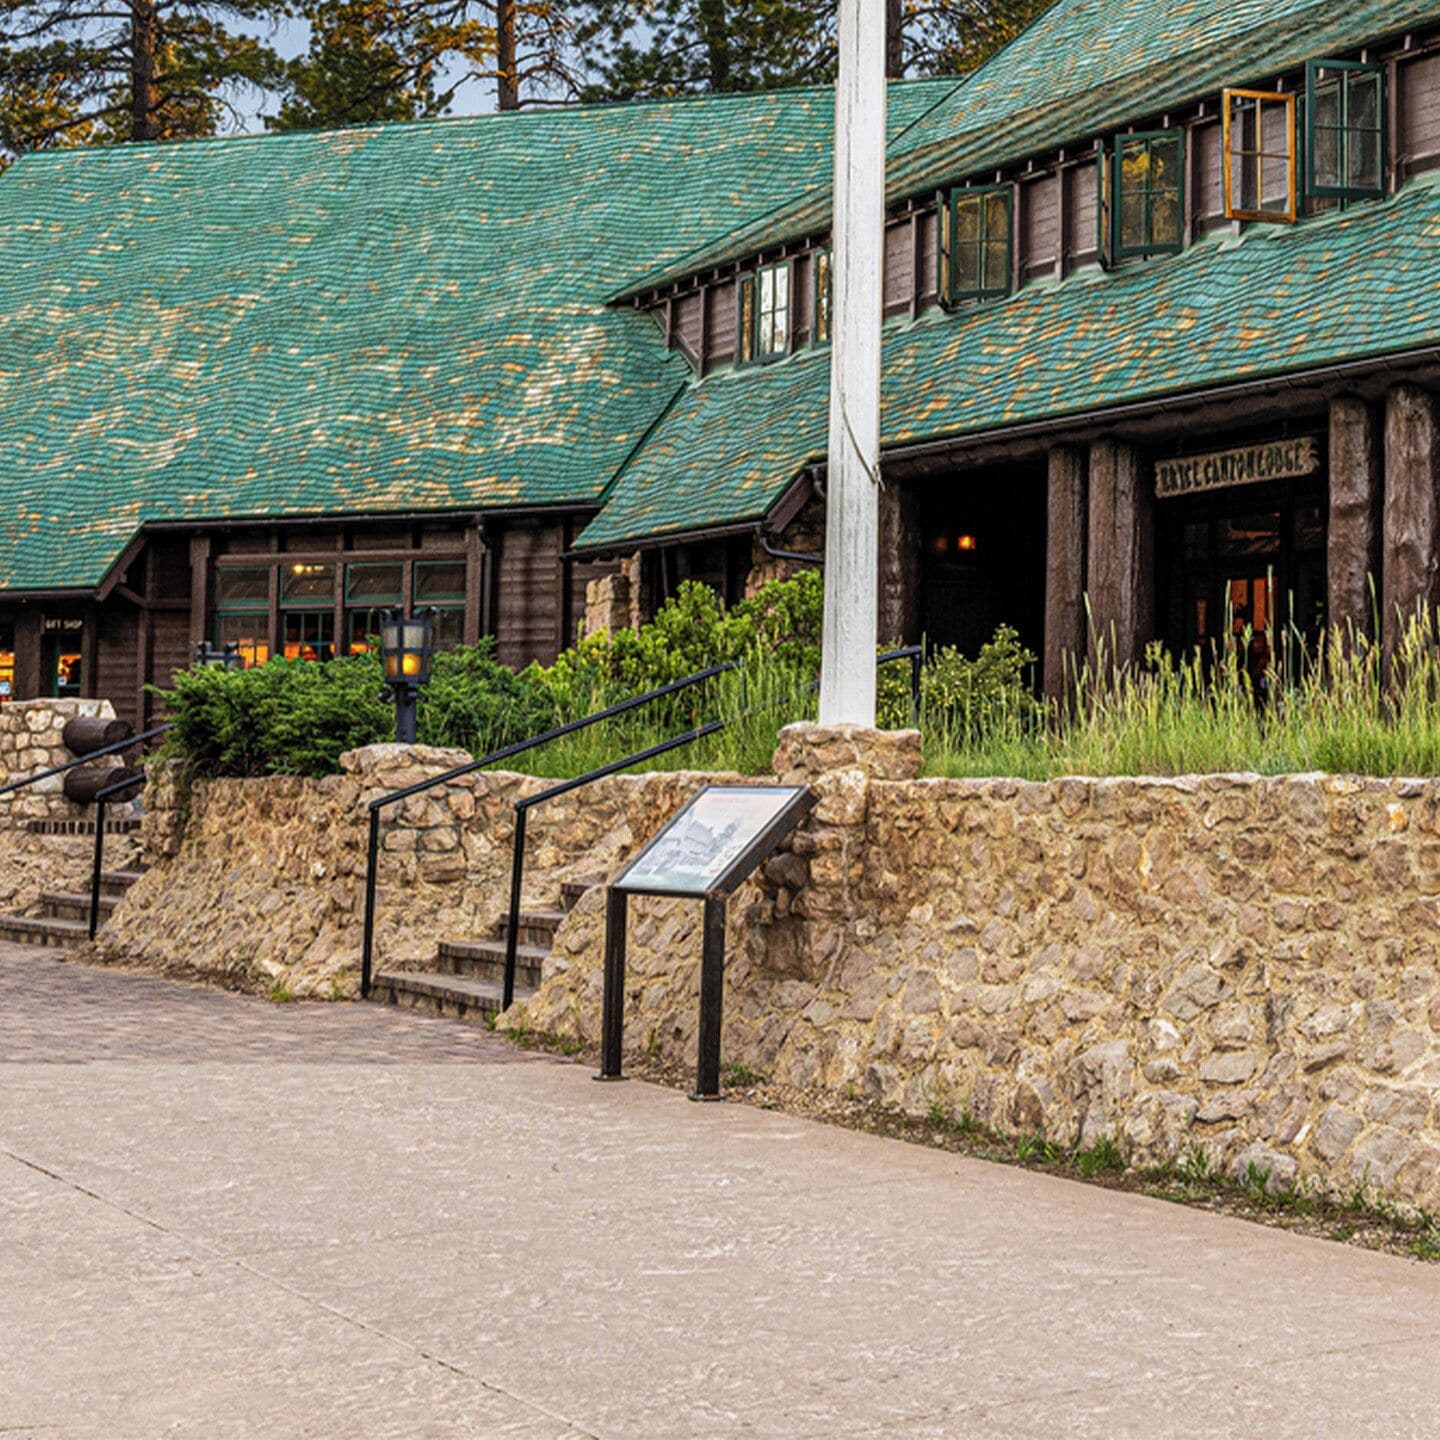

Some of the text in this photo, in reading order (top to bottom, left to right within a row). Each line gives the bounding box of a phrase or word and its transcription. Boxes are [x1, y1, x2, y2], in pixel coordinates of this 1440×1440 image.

[1160, 443, 1304, 492] BRYCE CANYON LODGE
[64, 619, 83, 629] SHOP
